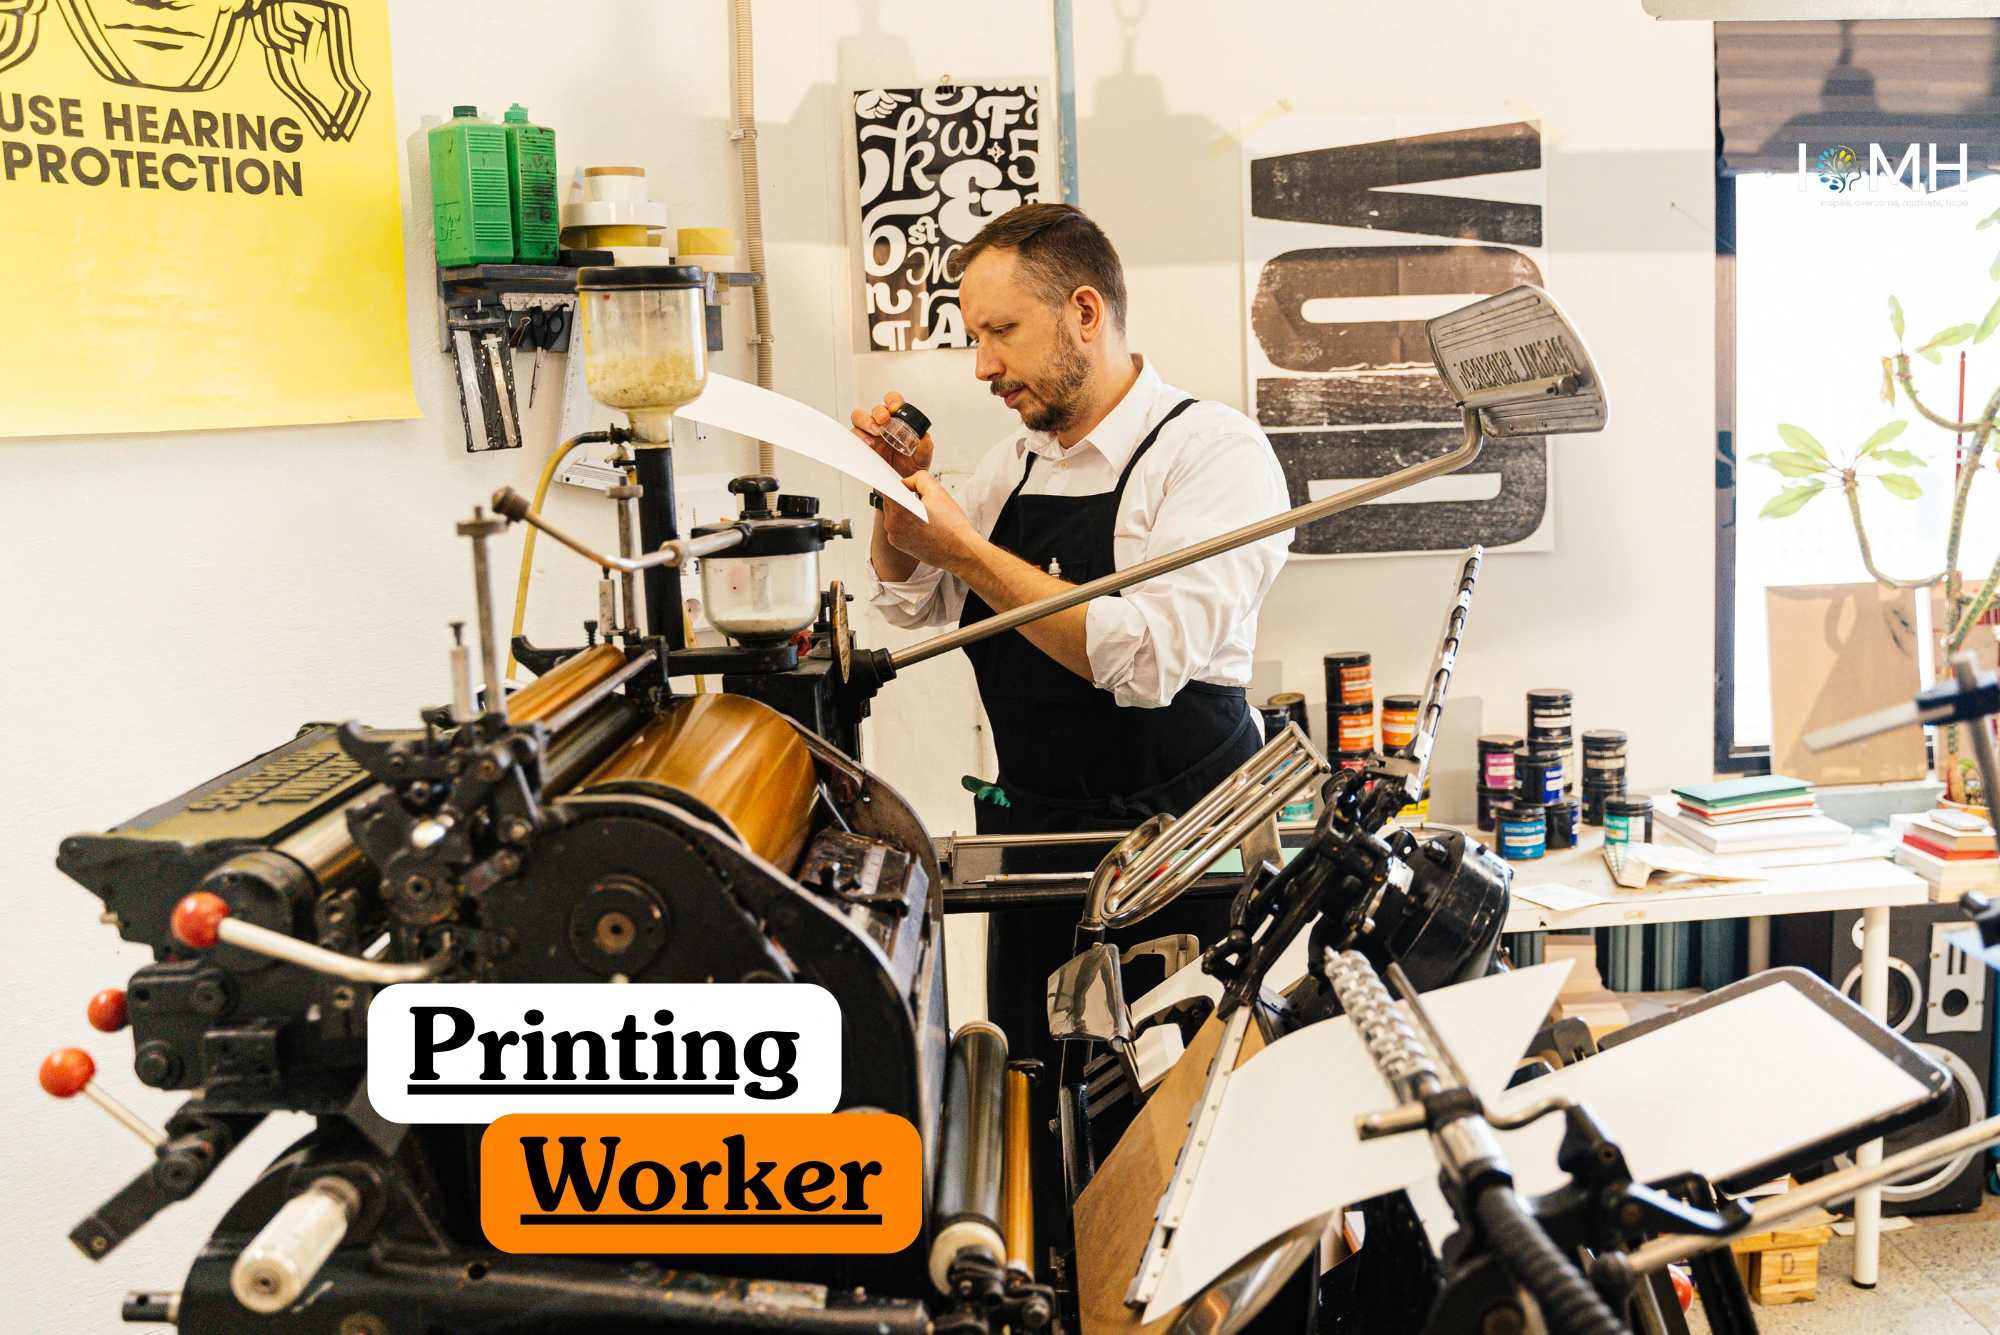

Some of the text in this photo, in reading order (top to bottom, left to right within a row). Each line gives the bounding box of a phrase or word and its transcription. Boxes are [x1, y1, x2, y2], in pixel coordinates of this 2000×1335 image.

[0, 92, 303, 154] USE HEARING
[2, 141, 303, 197] PROTECTION
